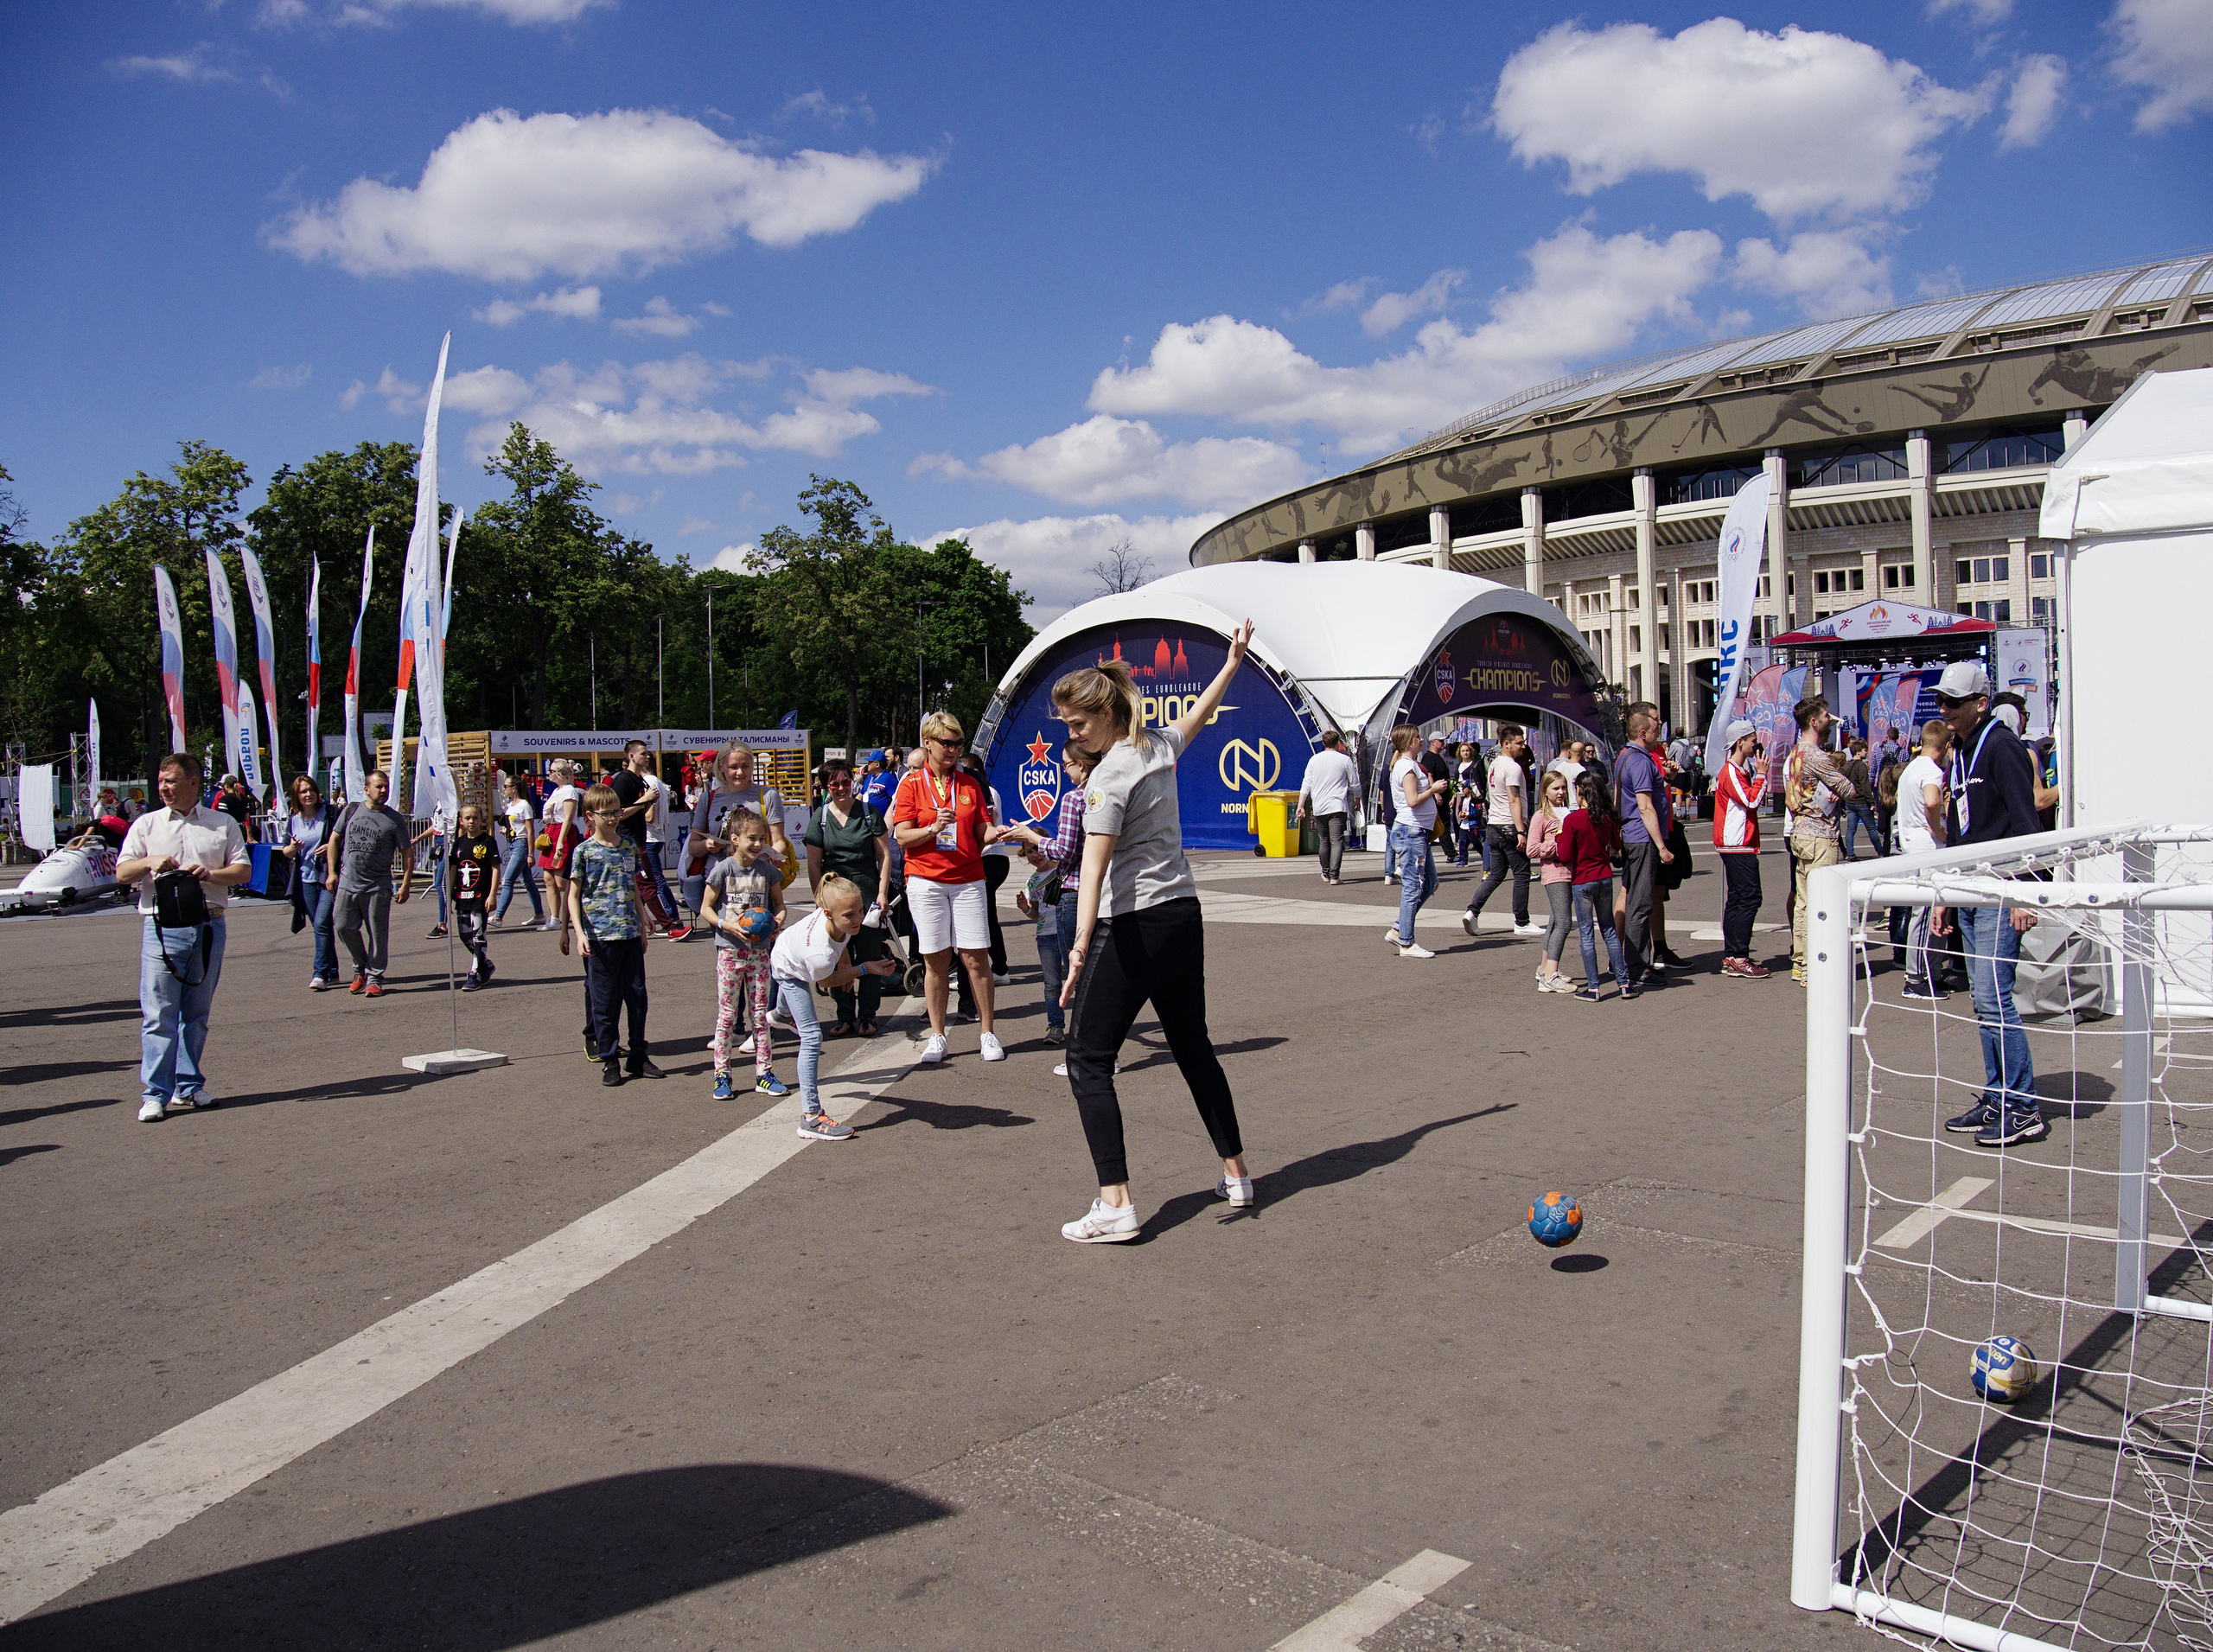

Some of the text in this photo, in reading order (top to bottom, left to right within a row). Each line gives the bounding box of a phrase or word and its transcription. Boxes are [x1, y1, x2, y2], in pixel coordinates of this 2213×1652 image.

[1437, 669, 1453, 680] CSKA
[1470, 667, 1540, 692] CHAMPIONS
[1156, 682, 1202, 694] EUROLEAGUE
[524, 737, 577, 746] SOUVENIRS
[1024, 769, 1055, 785] CSKA
[349, 821, 382, 841] CHANGING
